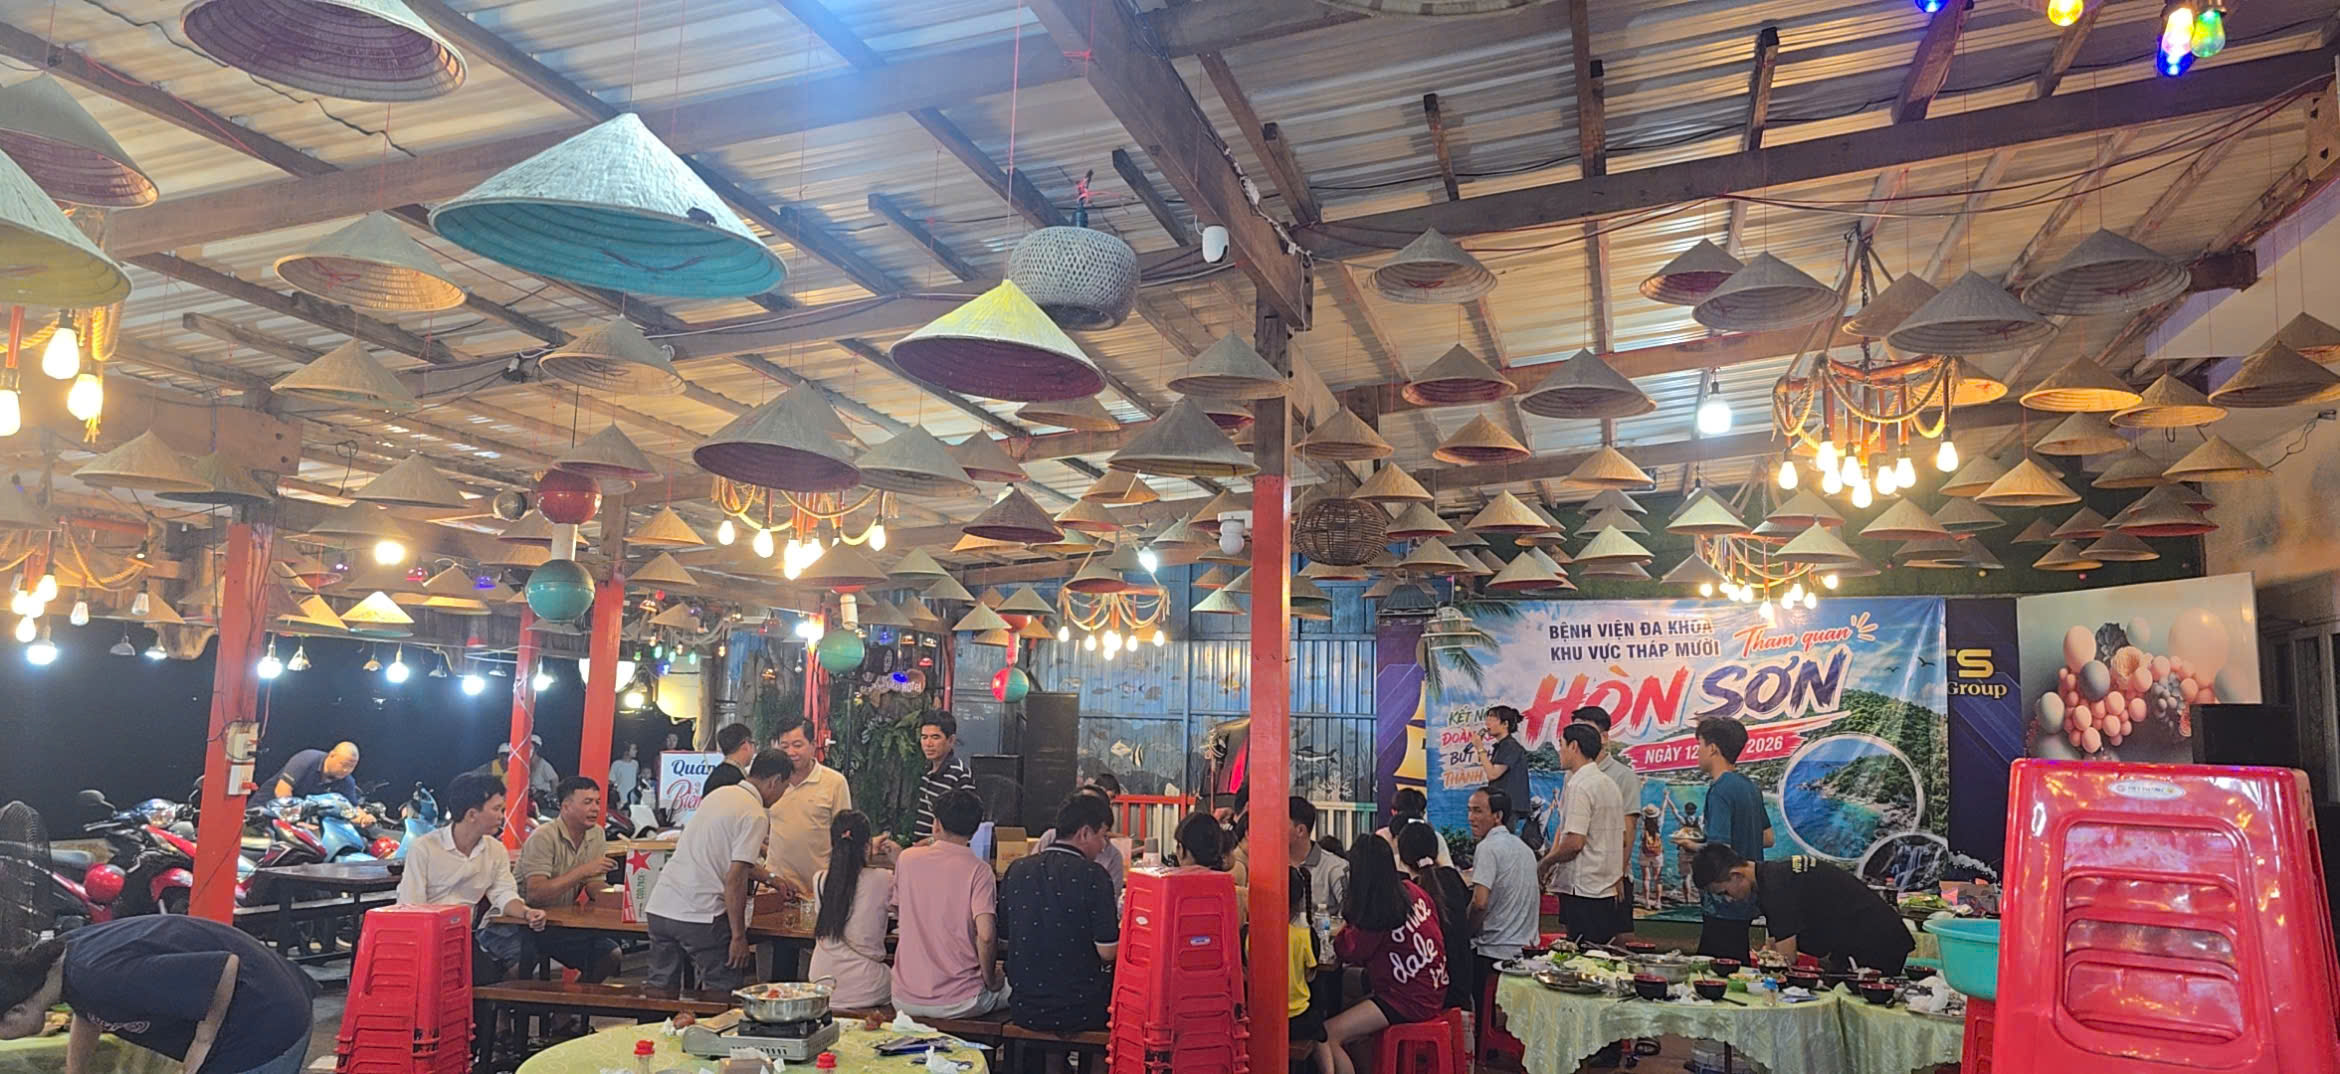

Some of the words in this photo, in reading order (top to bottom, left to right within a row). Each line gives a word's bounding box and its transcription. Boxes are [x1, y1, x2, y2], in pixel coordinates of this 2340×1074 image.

[1549, 621, 1592, 642] BỆNH
[1597, 620, 1634, 641] VIỆN
[1640, 621, 1663, 637] ĐA
[1734, 624, 1796, 659] Tham
[1802, 627, 1851, 652] quan
[1551, 646, 1583, 662] KHU
[1588, 643, 1622, 663] VỰC
[1626, 639, 1669, 659] THÁP
[1675, 638, 1720, 657] MƯỜI
[1522, 664, 1690, 743] HÒN
[1693, 647, 1848, 720] SƠN
[1947, 681, 2008, 699] Group
[1449, 706, 1473, 725] KẾT
[1644, 744, 1682, 764] NGÀY
